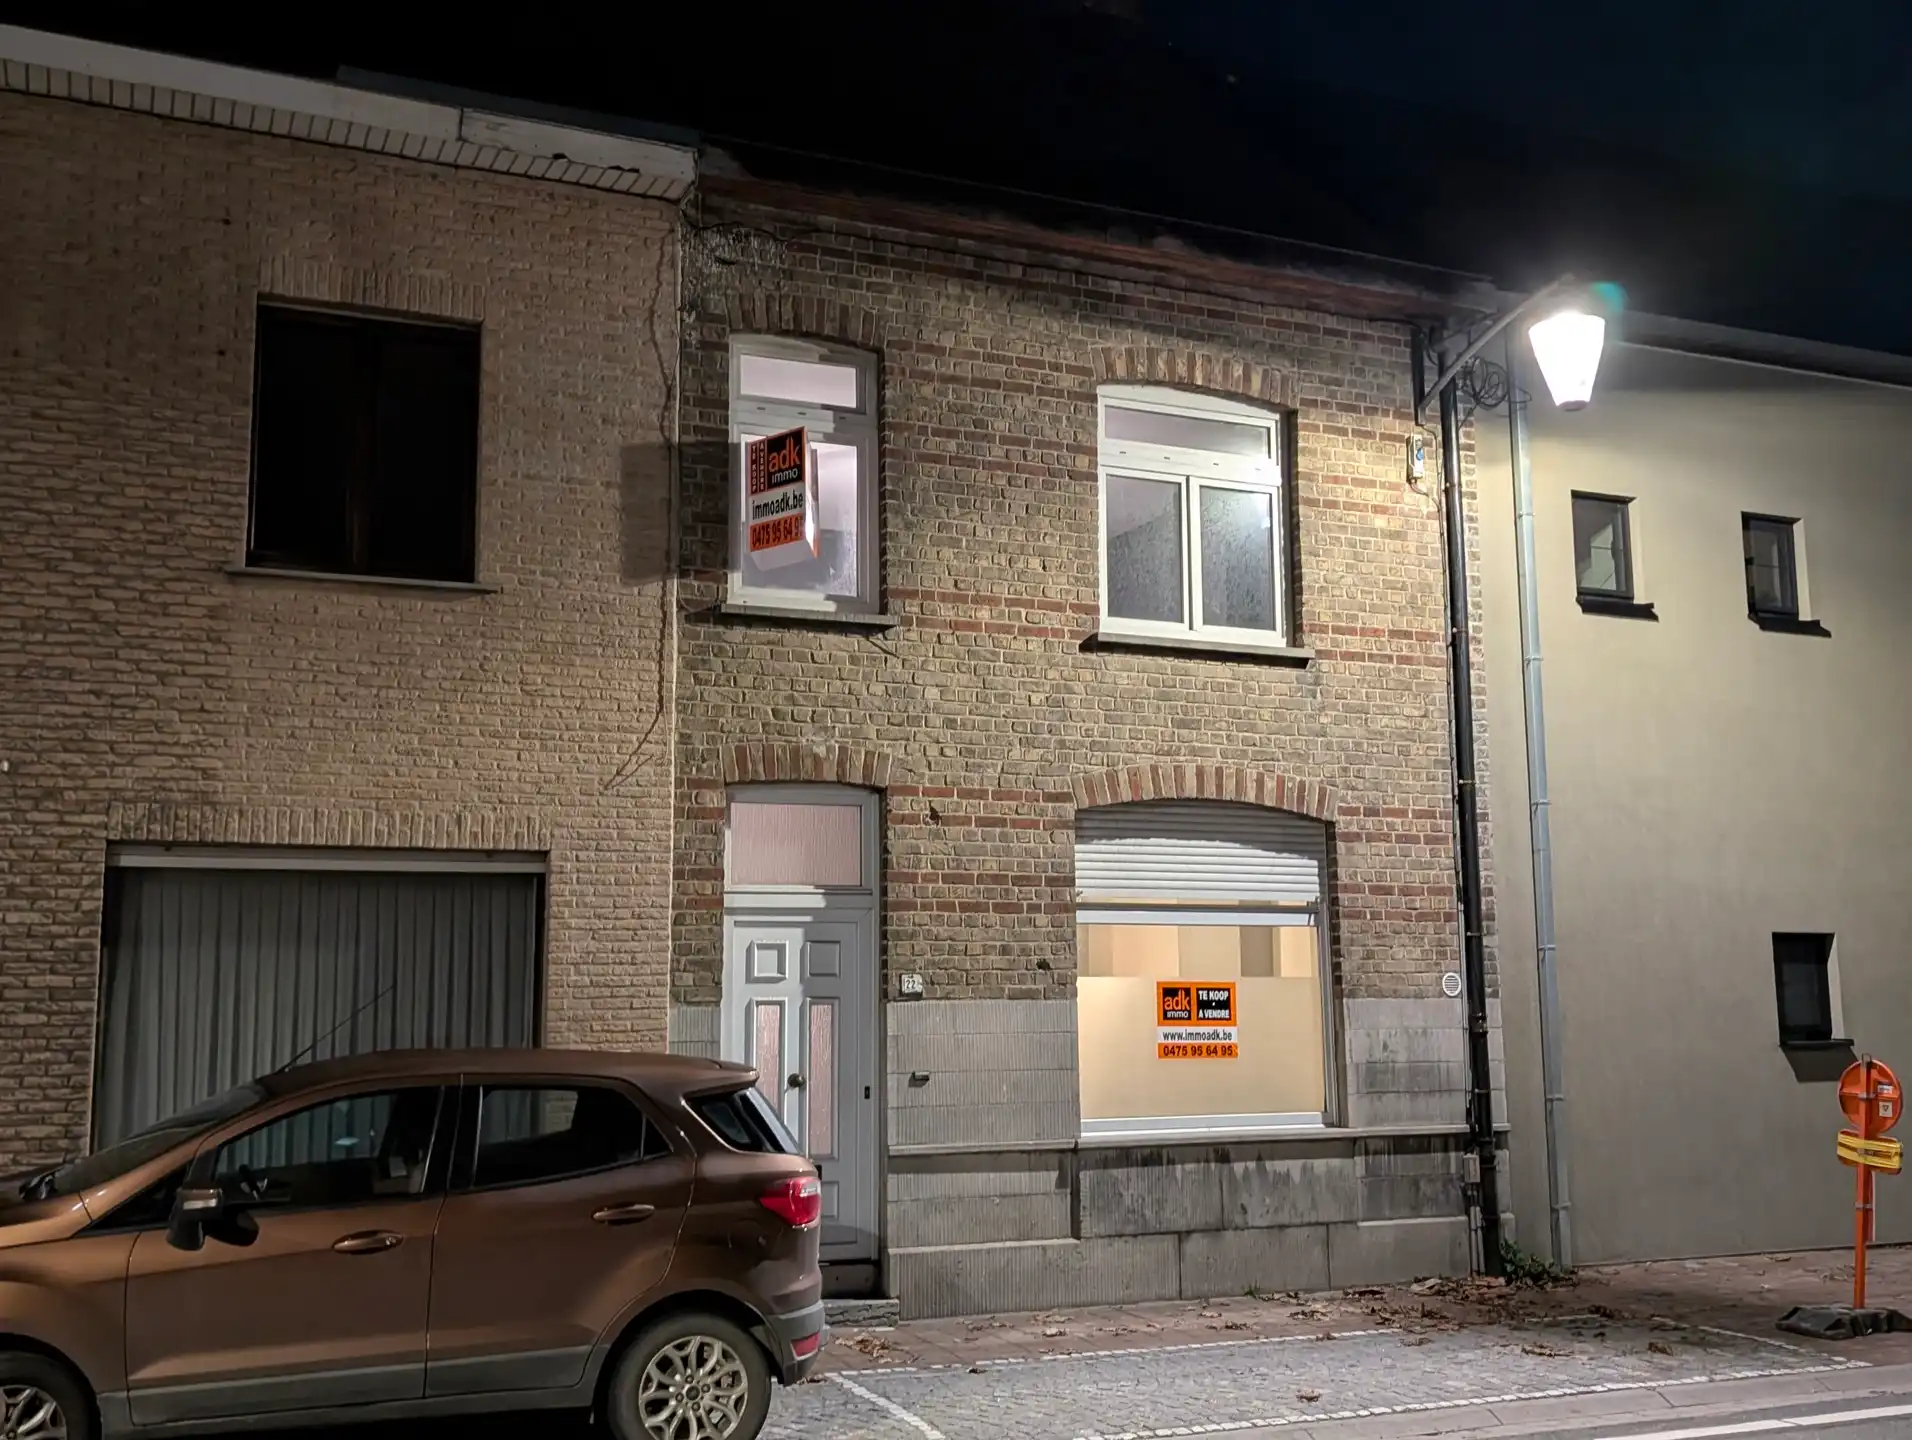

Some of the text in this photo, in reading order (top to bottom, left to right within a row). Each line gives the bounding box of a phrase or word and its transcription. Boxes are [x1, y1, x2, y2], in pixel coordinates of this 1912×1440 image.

[768, 436, 801, 472] adk
[771, 468, 798, 485] immo
[752, 490, 804, 520] immoadk.be
[752, 523, 771, 548] 0475
[771, 520, 782, 544] 95
[783, 517, 793, 541] 64
[905, 979, 916, 989] 22
[1164, 989, 1190, 1010] adk
[1198, 990, 1229, 1001] TE KOOP
[1167, 1010, 1189, 1018] immo
[1198, 1009, 1230, 1018] A VENDRE
[1163, 1029, 1232, 1041] www.immoadk.be
[1163, 1045, 1233, 1056] 0475 95 64 95
